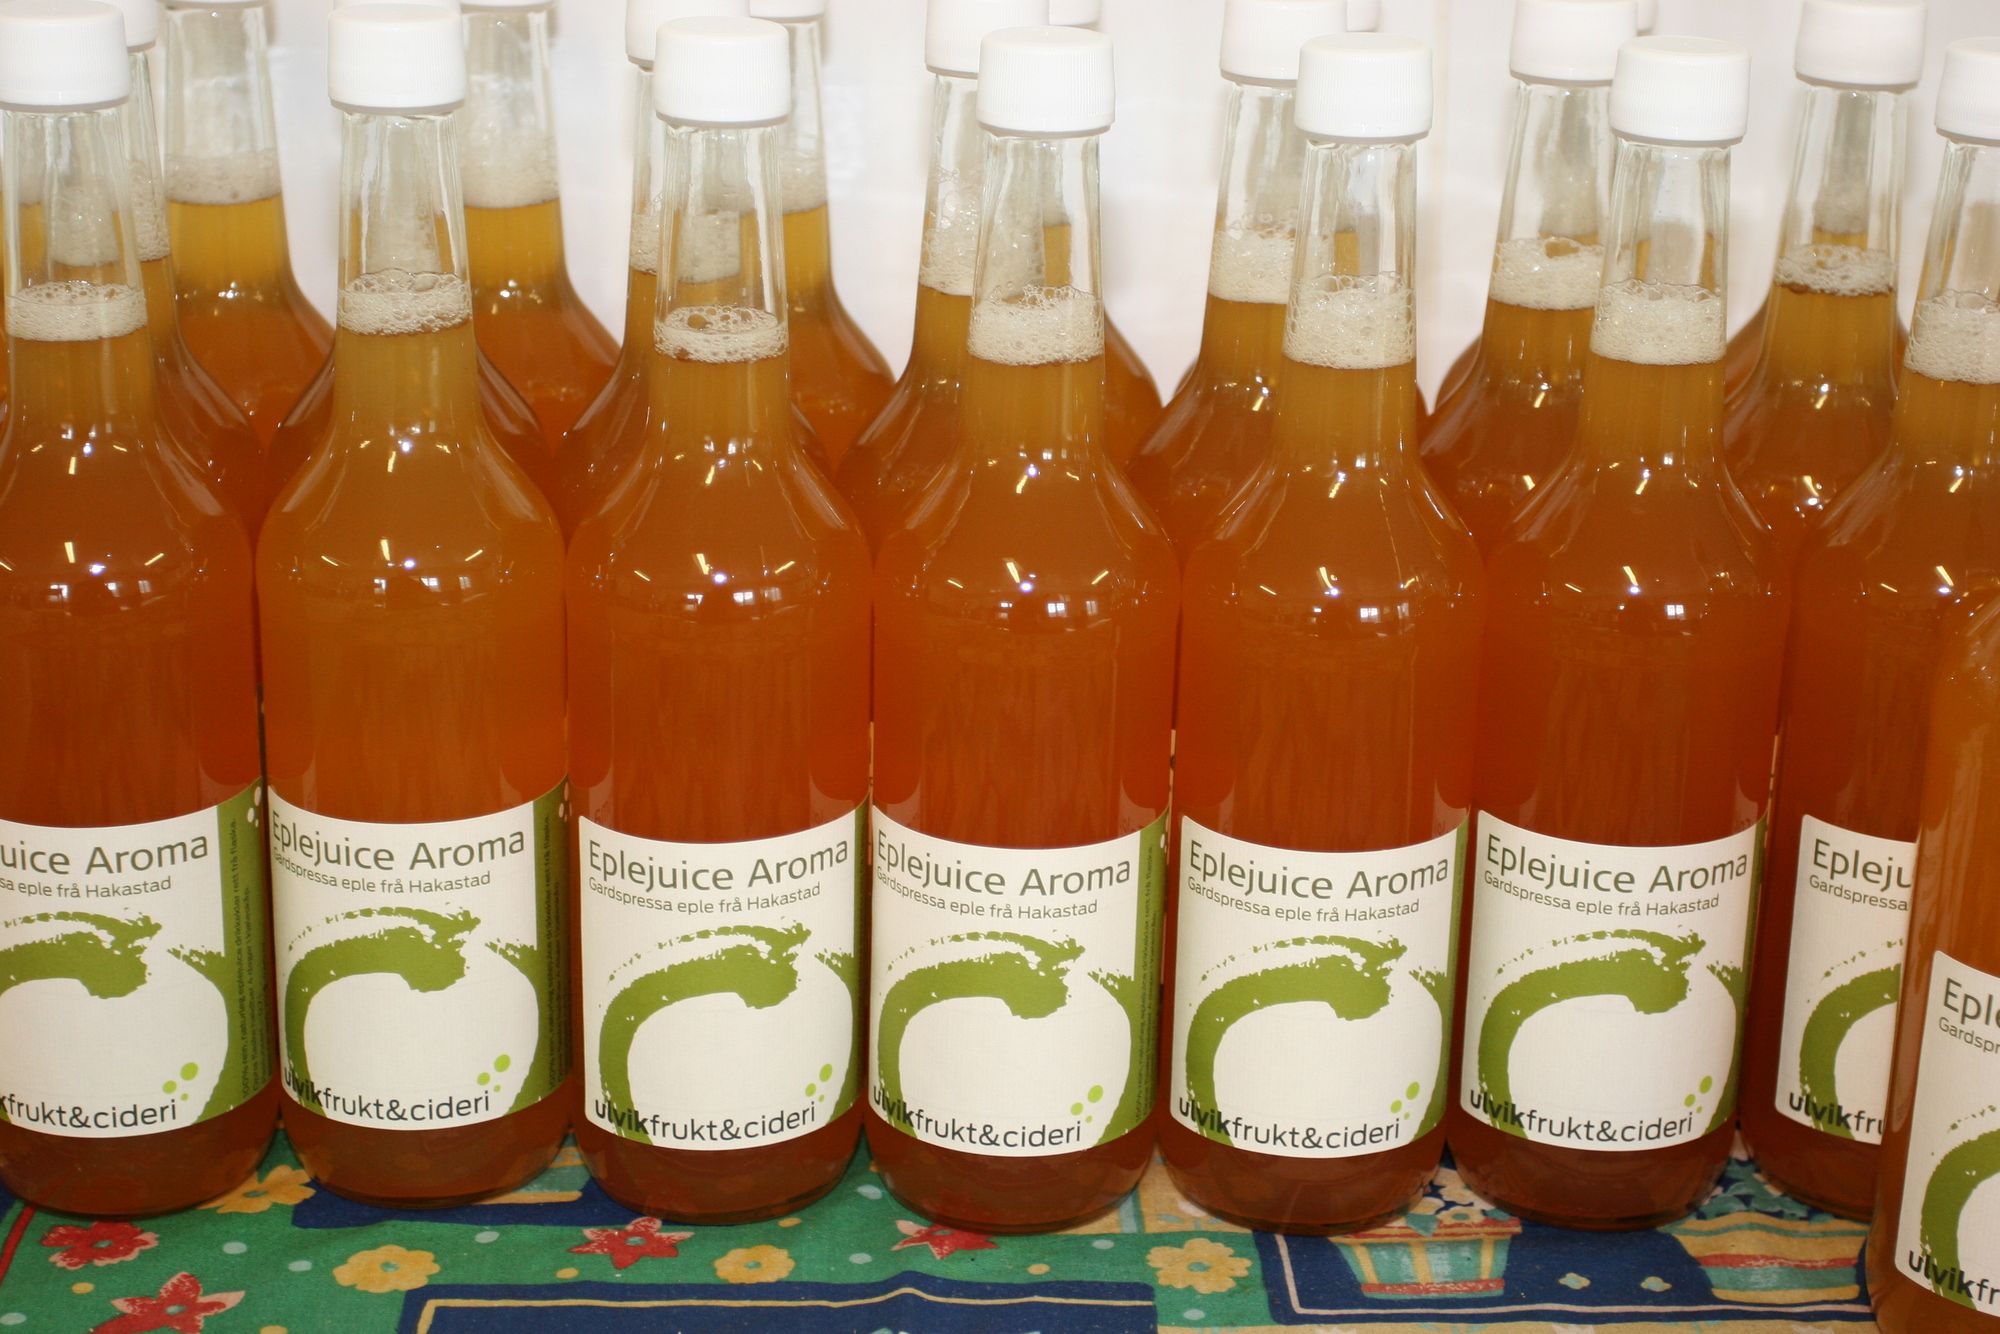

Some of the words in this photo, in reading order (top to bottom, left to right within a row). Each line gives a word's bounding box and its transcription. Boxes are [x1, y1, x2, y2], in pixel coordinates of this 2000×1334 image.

[86, 835, 208, 875] Aroma
[272, 810, 394, 870] Eplejuice
[409, 831, 525, 870] Aroma
[878, 829, 1006, 895] Eplejuice
[1020, 860, 1131, 896] Aroma
[1487, 833, 1635, 893] Eplejuice
[1649, 854, 1747, 893] Aroma
[18, 882, 52, 897] eple
[56, 883, 81, 898] frå
[86, 876, 171, 898] Hakastad
[273, 847, 338, 887] Gardspressa
[341, 878, 376, 893] eple
[380, 879, 404, 894] frå
[409, 871, 491, 893] Hakastad
[589, 840, 734, 893] Eplejuice
[748, 840, 848, 888] Aroma
[877, 866, 946, 909] Gardspressa
[950, 901, 985, 916] eple
[990, 903, 1013, 919] frå
[1018, 900, 1098, 919] Hakastad
[1190, 839, 1333, 899] Eplejuice
[1346, 858, 1448, 899] Aroma
[589, 876, 673, 911] Gardspressa
[677, 901, 714, 915] eple
[719, 900, 742, 913] frå
[748, 882, 821, 911] Hakastad
[1188, 876, 1270, 916] Gardspressa
[1275, 907, 1311, 922] eple
[1317, 907, 1339, 922] frå
[1345, 899, 1419, 922] Hakastad
[1484, 870, 1571, 910] Gardspressa
[1576, 900, 1612, 916] eple
[1618, 901, 1641, 916] frå
[1646, 893, 1719, 916] Hakastad
[1809, 875, 1909, 912] Gardspressa
[595, 1099, 815, 1141] ulvikfrukt&cideri
[873, 1085, 1081, 1147] ulvikfrukt&cideri
[1179, 1097, 1400, 1149] ulvikfrukt&cideri
[1470, 1090, 1693, 1142] ulvikfrukt&cideri
